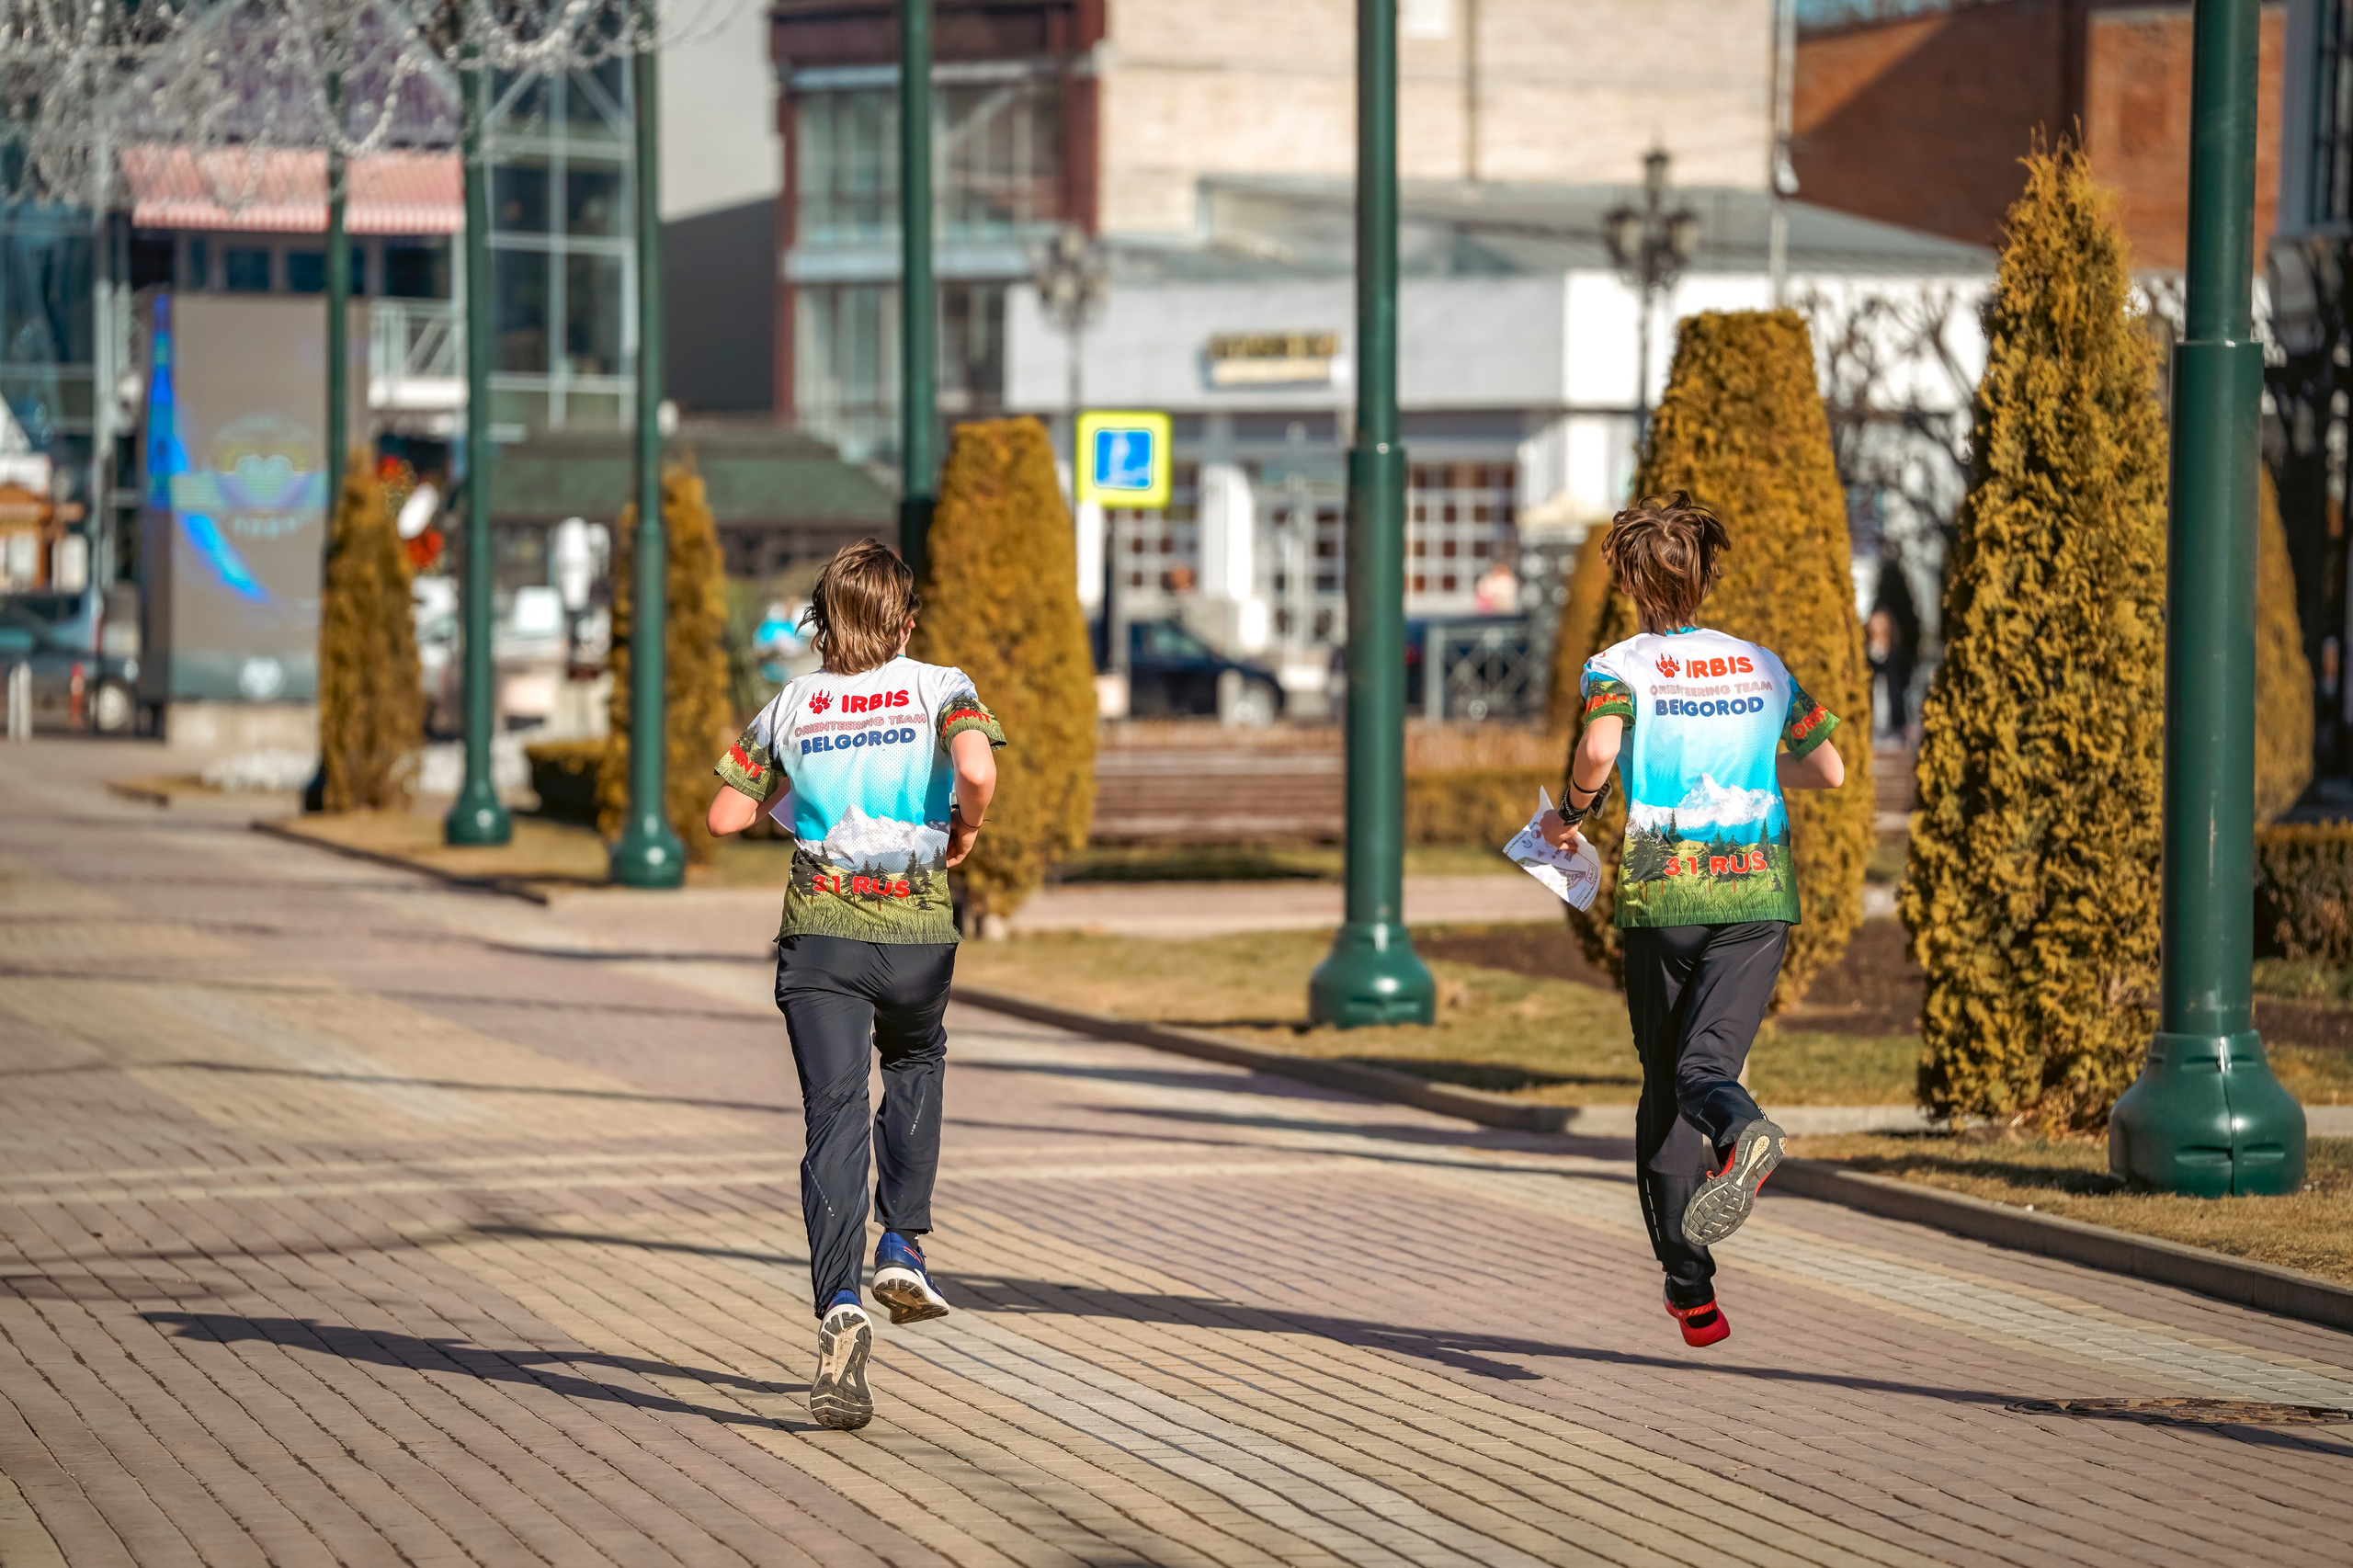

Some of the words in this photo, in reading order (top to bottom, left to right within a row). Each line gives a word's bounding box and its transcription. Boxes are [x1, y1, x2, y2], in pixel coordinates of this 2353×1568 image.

[1686, 655, 1754, 679] IRBIS
[1733, 680, 1773, 694] TEAM
[841, 689, 910, 713] IRBIS
[794, 716, 884, 737] ORIENTEERING
[888, 712, 927, 725] TEAM
[801, 727, 916, 756] BELGOROD
[1665, 856, 1699, 876] 31
[1710, 851, 1768, 875] RUS
[813, 875, 841, 894] 31
[852, 875, 911, 899] RUS
